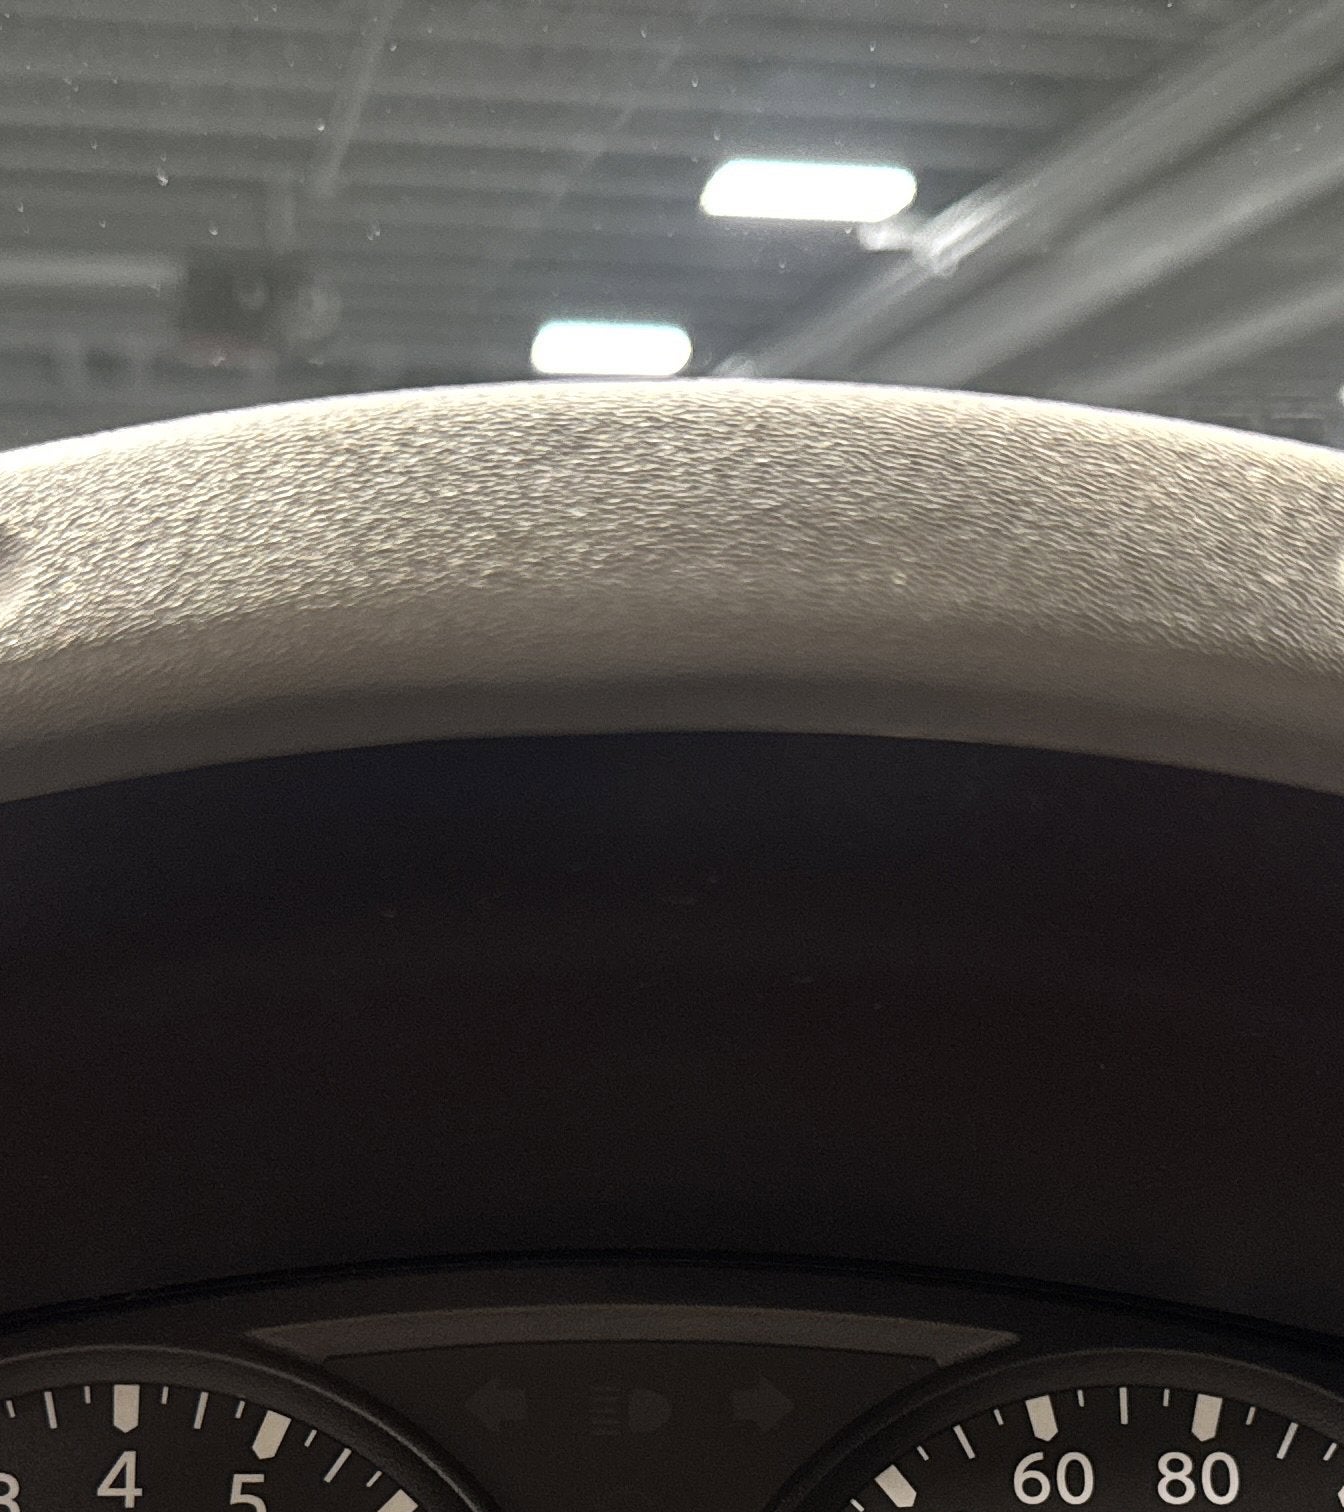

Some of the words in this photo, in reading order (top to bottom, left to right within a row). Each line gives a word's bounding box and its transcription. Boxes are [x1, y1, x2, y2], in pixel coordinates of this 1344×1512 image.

[96, 1450, 143, 1509] 4
[1013, 1451, 1094, 1505] 60
[1157, 1451, 1240, 1506] 80
